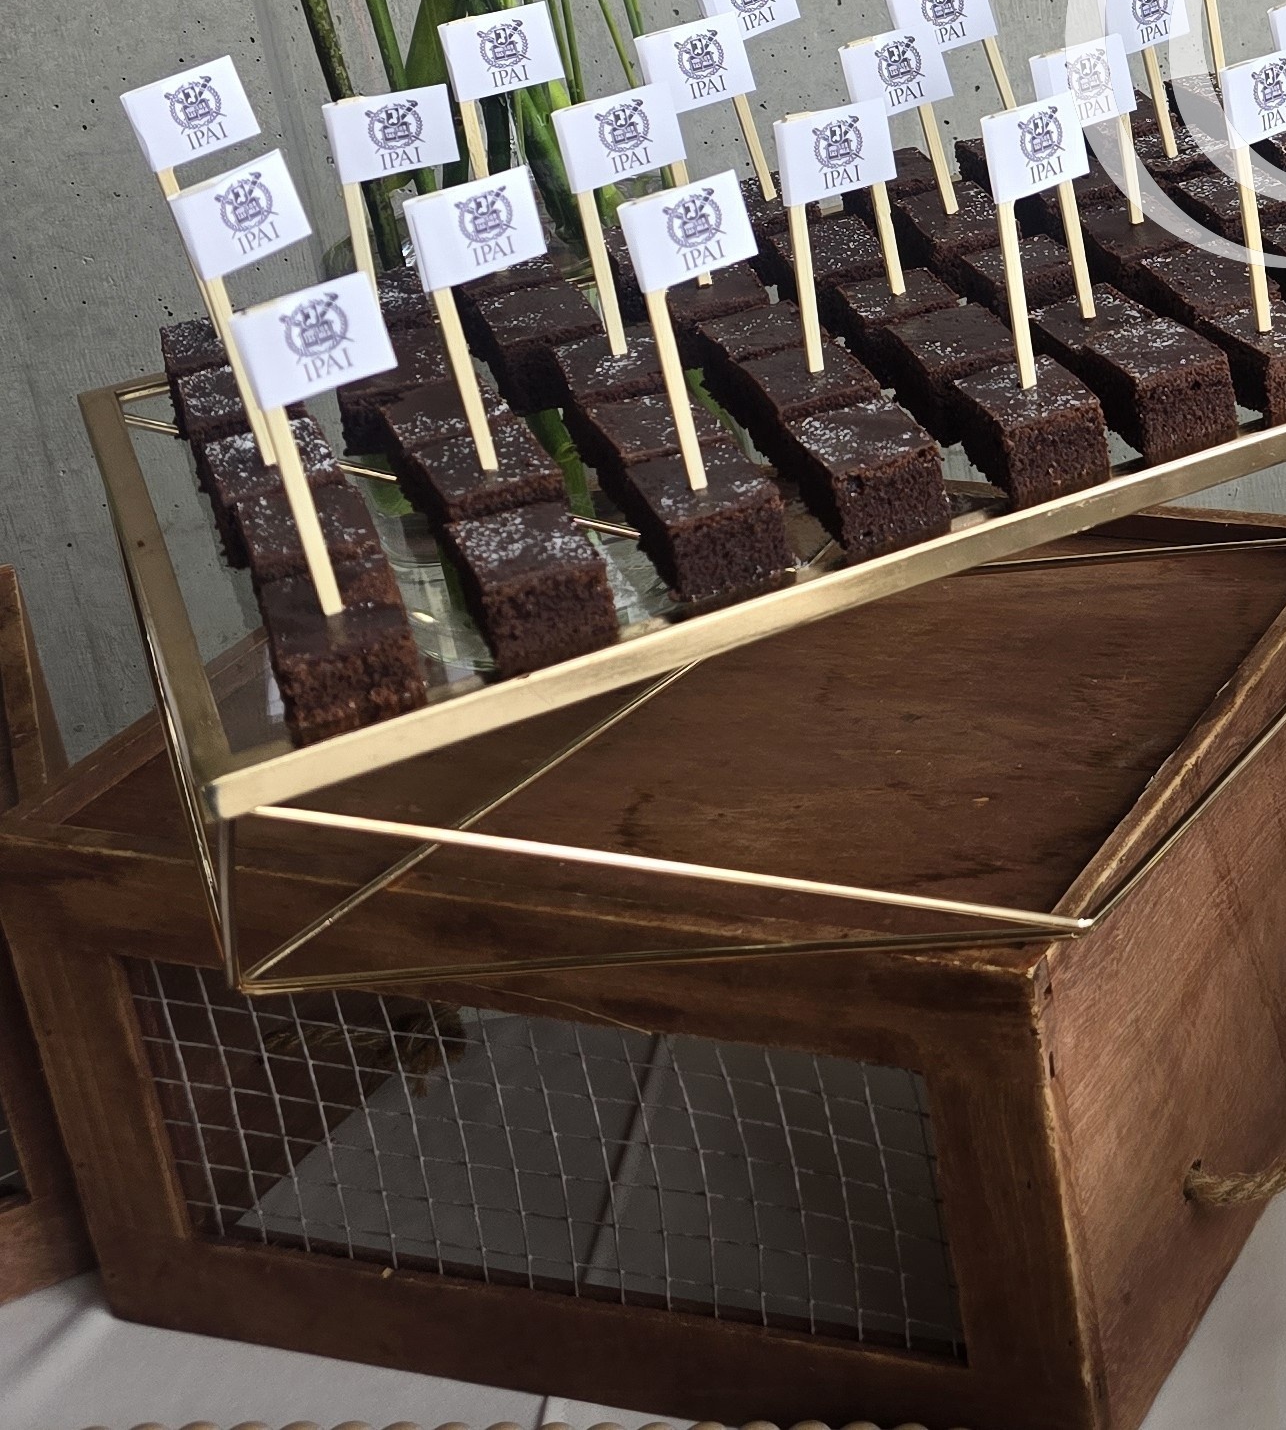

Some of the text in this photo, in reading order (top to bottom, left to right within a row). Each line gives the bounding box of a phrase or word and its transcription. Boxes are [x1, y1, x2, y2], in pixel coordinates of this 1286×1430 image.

[742, 7, 775, 30] IPAI
[1141, 19, 1169, 44] IPAI
[492, 65, 529, 87] IPAI
[690, 75, 726, 99] IPAI
[889, 81, 925, 106] IPAI
[187, 122, 228, 150] IPAI
[380, 147, 422, 170] IPAI
[612, 147, 651, 173] IPAI
[1030, 156, 1064, 183] IPAI
[824, 165, 861, 189] IPAI
[238, 221, 280, 254] IPAI
[473, 236, 515, 265] IPAI
[682, 240, 725, 271] IPAI
[304, 349, 353, 381] IPAI
